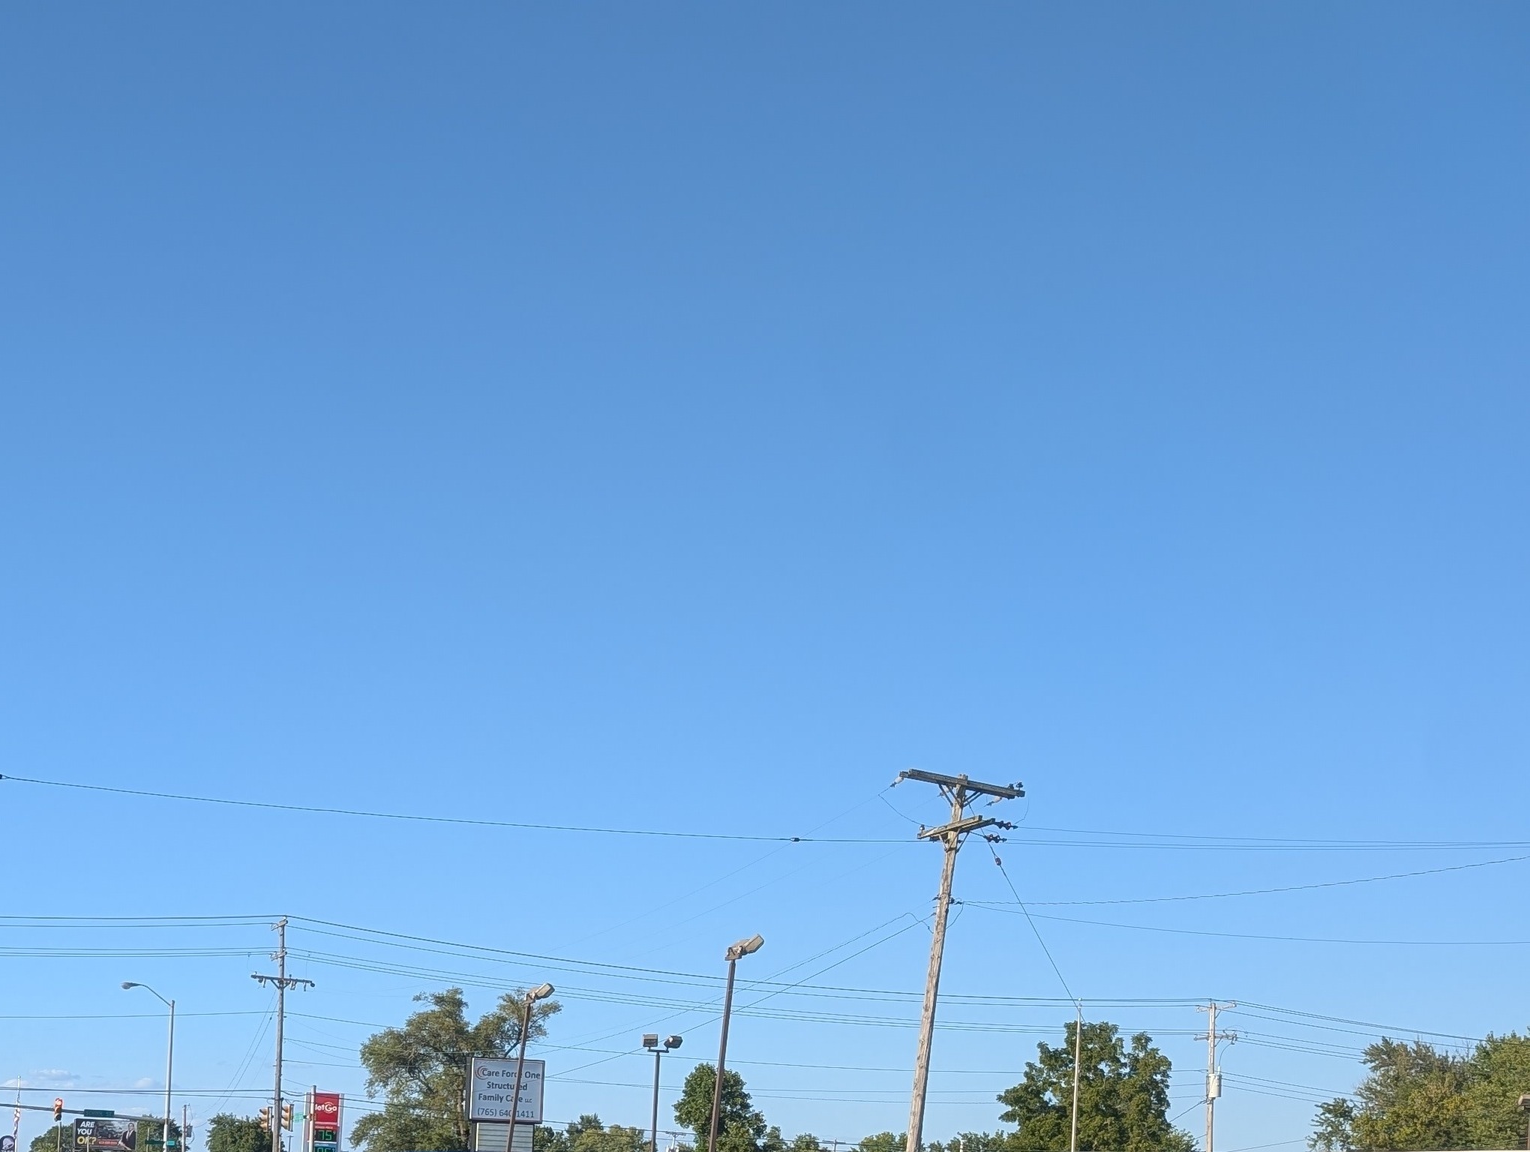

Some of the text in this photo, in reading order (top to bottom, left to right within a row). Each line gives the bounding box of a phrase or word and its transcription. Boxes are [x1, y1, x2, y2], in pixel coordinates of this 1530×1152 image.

[482, 1068, 540, 1079] Care Forc One
[487, 1081, 527, 1090] Structued
[478, 1093, 503, 1103] Family
[477, 1107, 534, 1118] (765) 6401411
